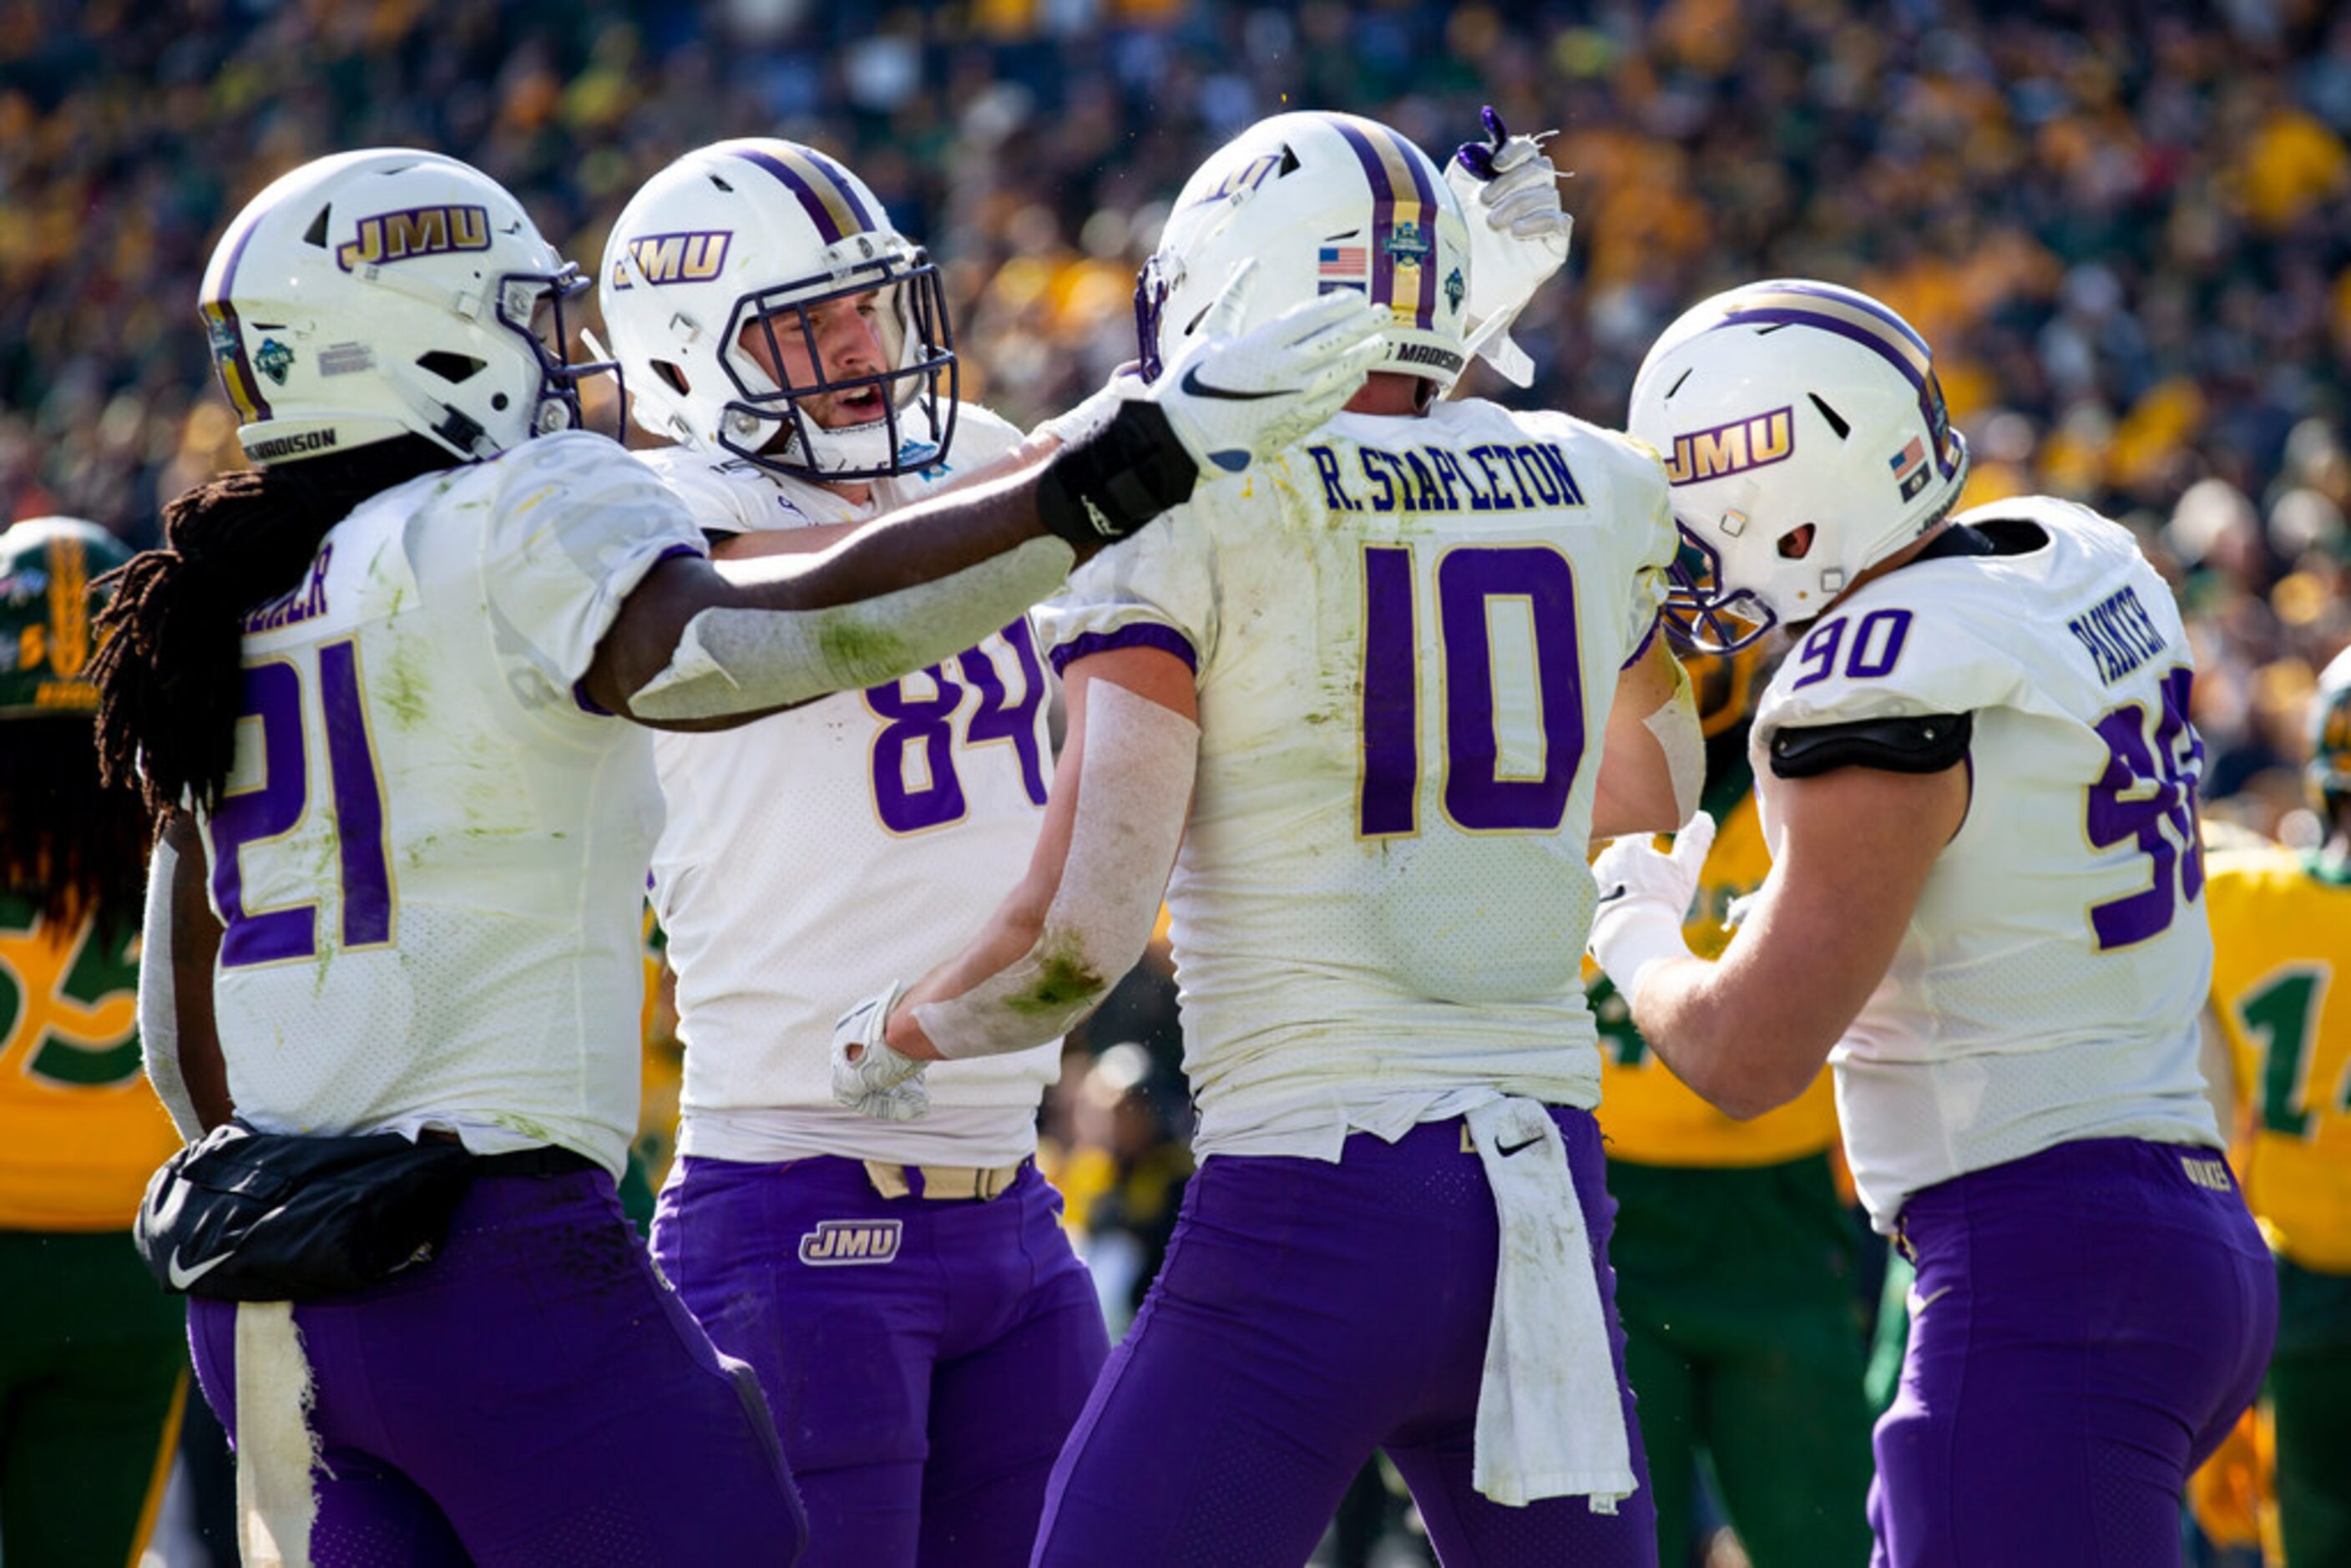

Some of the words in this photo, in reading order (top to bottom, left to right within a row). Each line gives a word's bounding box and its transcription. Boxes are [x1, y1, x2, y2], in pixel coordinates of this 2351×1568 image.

[336, 204, 493, 274] JMU
[1664, 405, 1793, 488] JMU
[1792, 608, 1914, 691] 90
[2067, 584, 2168, 687] PAINTER
[858, 614, 1049, 837] 84
[1354, 540, 1589, 839] 10
[214, 631, 398, 969] 21
[2237, 960, 2351, 1141] 1
[804, 1223, 898, 1261] JMU
